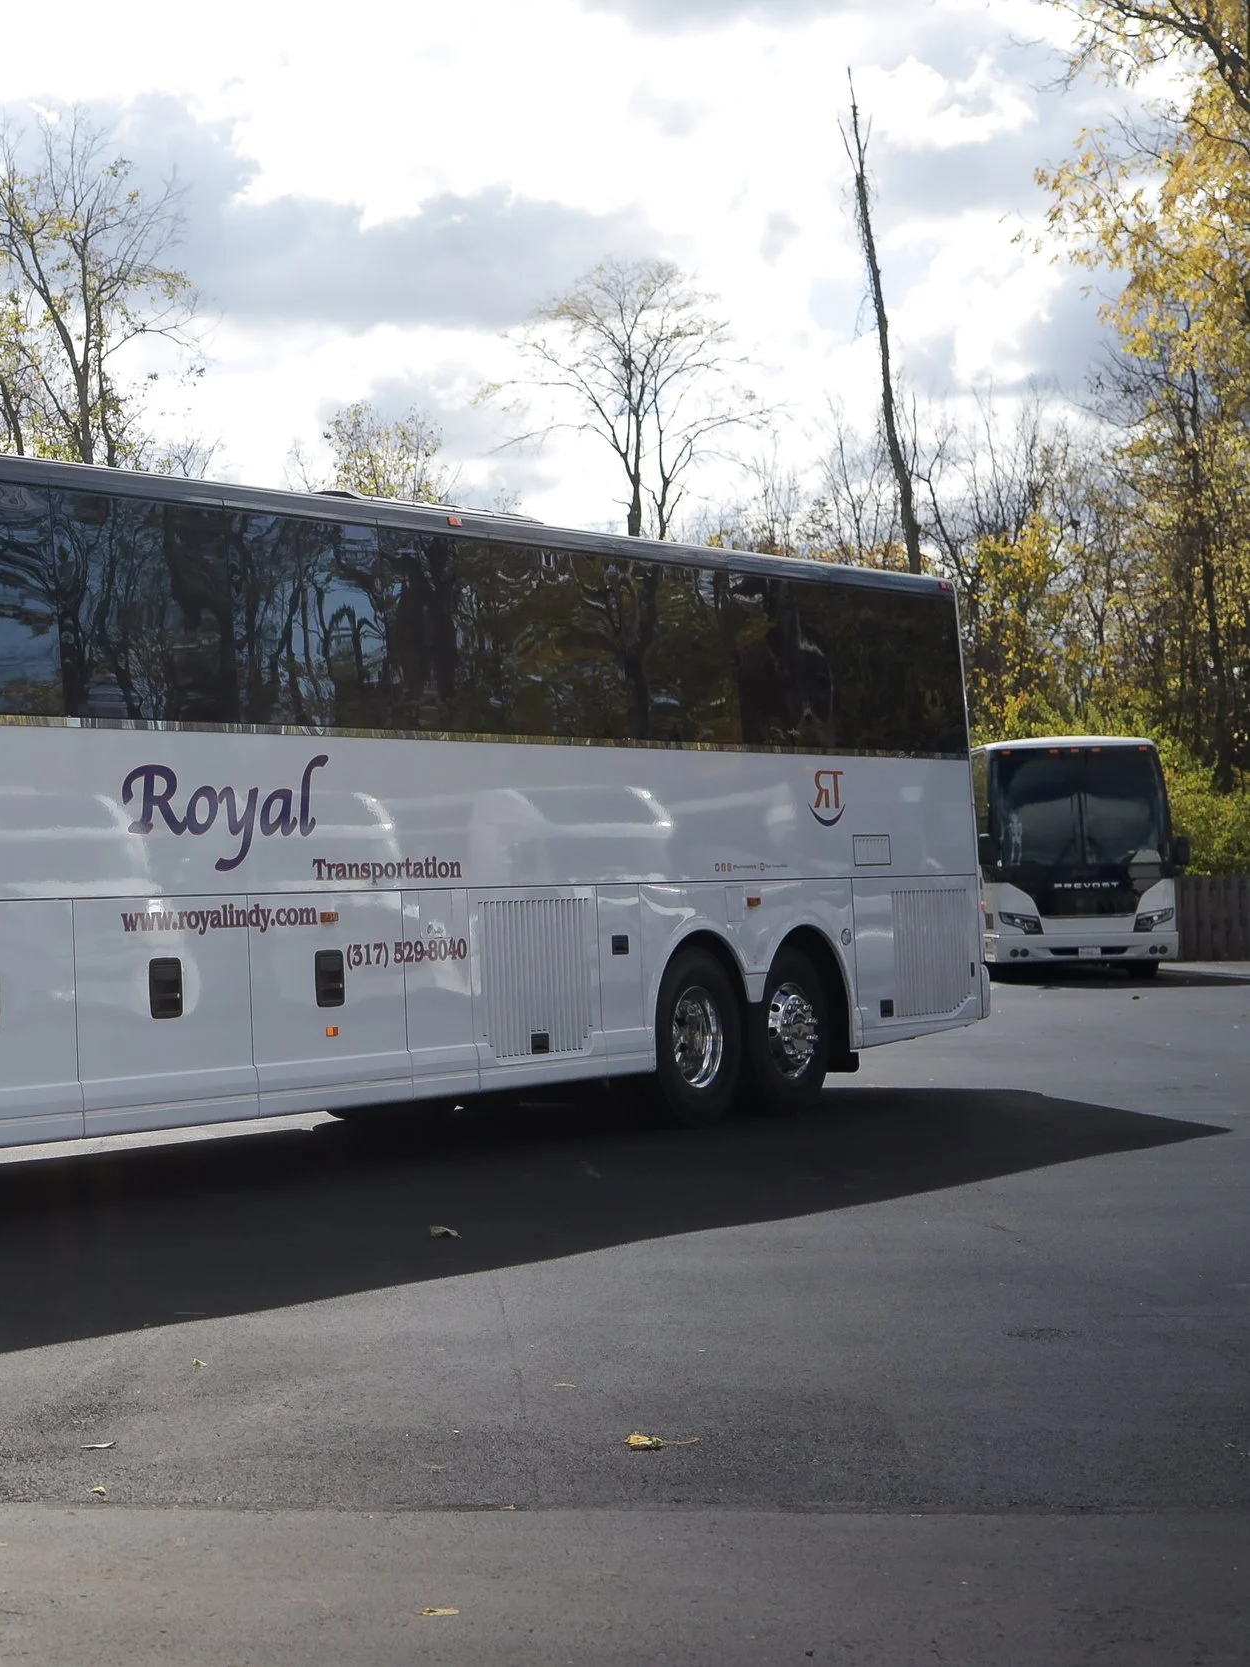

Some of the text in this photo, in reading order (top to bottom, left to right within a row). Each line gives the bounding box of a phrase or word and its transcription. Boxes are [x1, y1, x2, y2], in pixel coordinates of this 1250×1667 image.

[121, 754, 329, 872] Royal
[312, 856, 462, 885] Transportation
[121, 904, 318, 935] www.royalindy.com
[347, 938, 467, 969] (317) 529-8040
